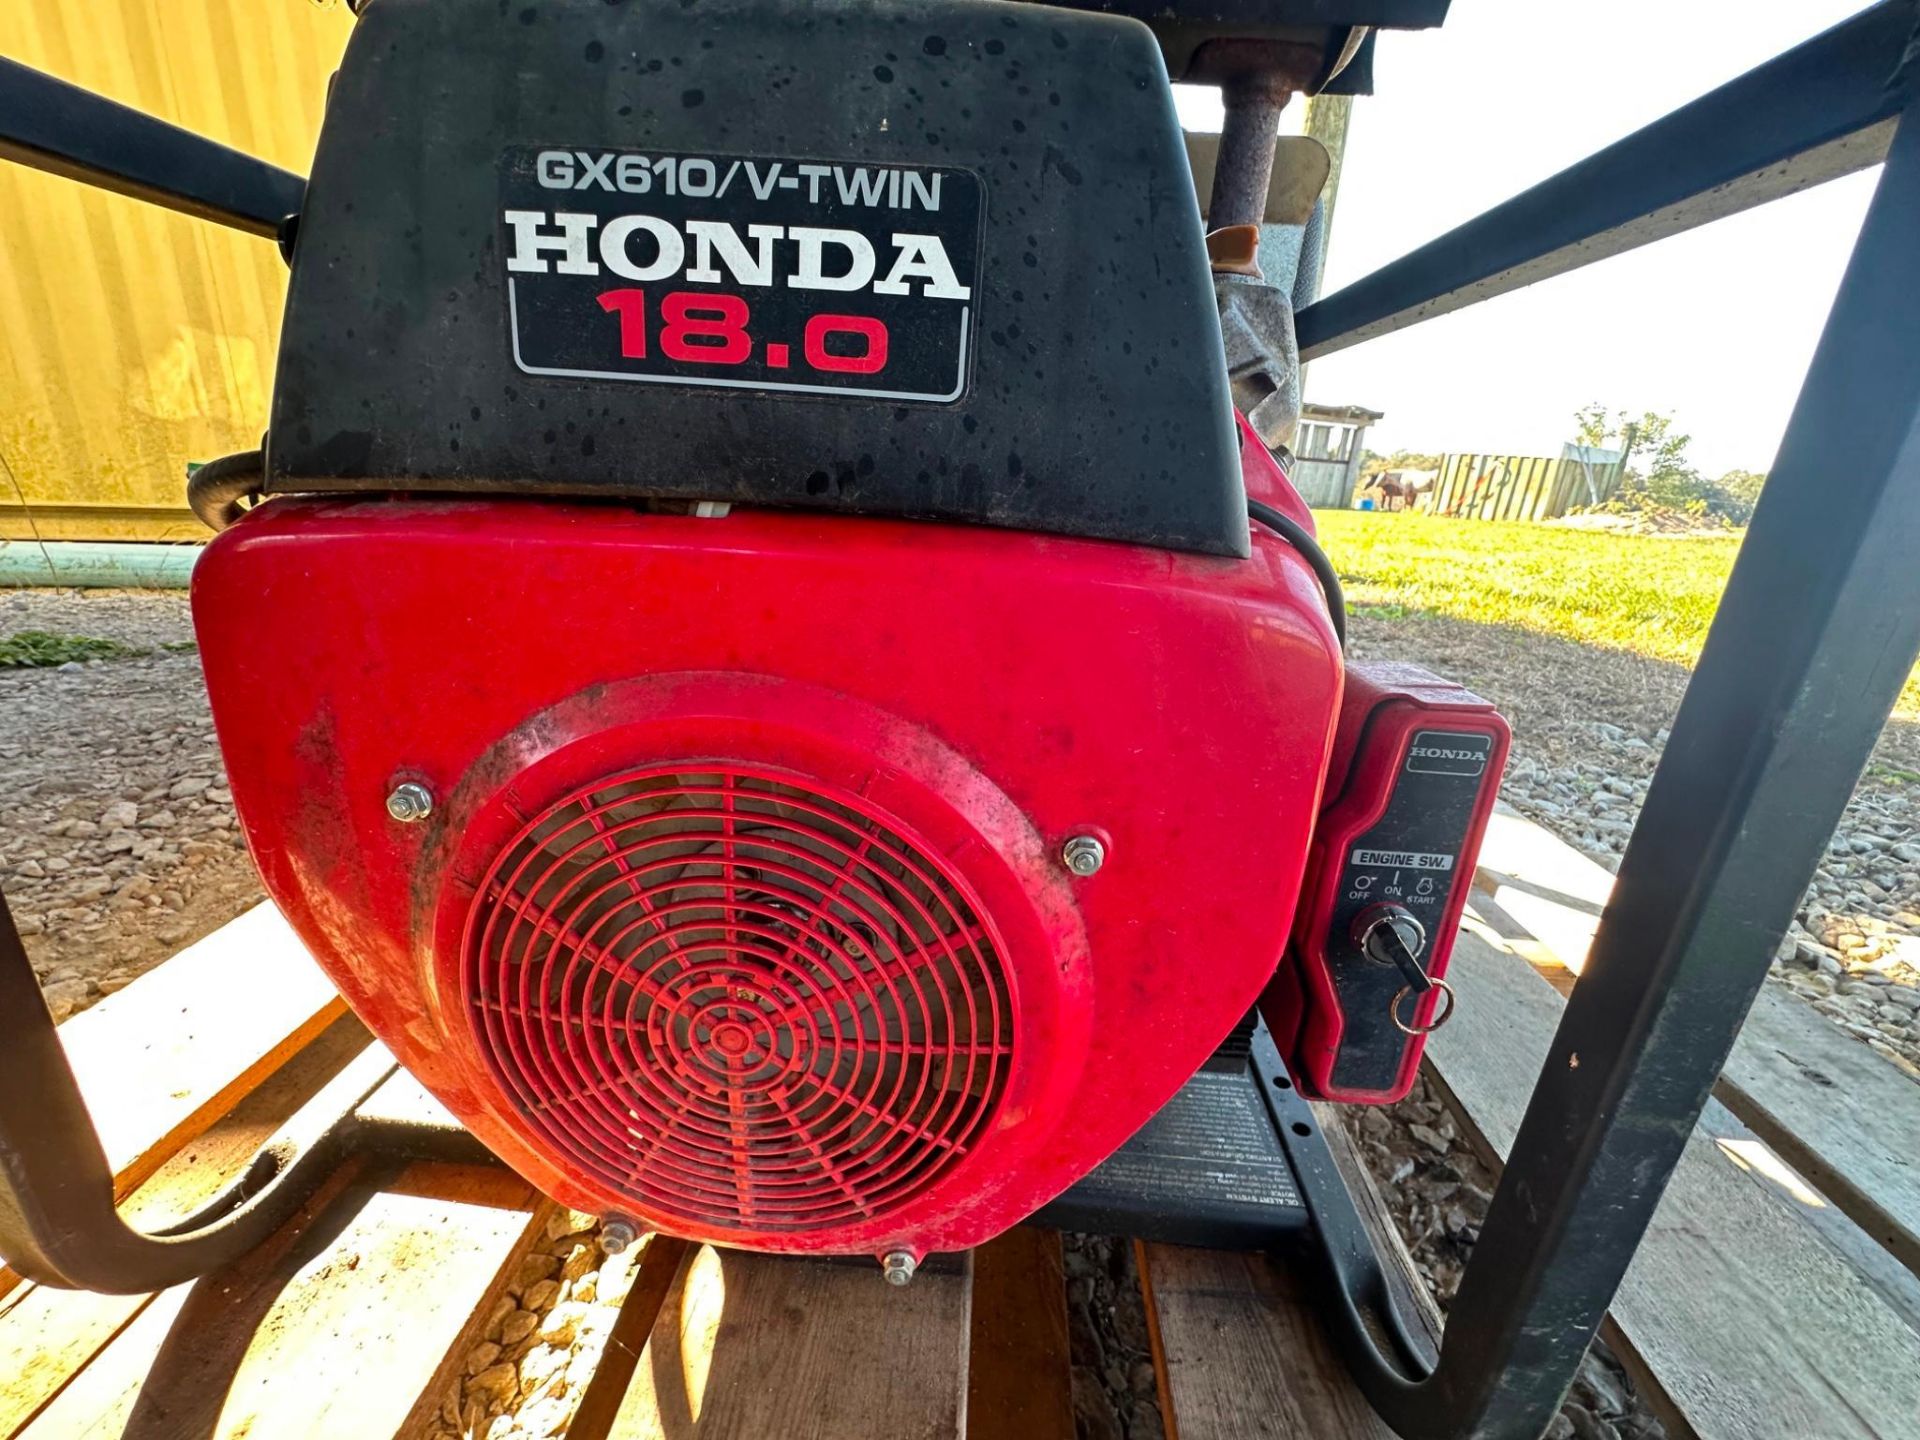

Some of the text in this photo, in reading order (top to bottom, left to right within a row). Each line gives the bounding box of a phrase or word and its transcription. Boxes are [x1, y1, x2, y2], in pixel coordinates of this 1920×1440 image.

[536, 150, 943, 212] GX610/V-TWIN
[504, 209, 971, 300] HONDA
[595, 288, 889, 374] 18.0
[1409, 746, 1487, 761] HONDA
[1359, 851, 1446, 869] ENGINE SW.
[1348, 891, 1371, 900] OFF
[1384, 885, 1402, 897] ON
[1406, 895, 1436, 905] START
[1259, 1195, 1284, 1206] ALERT
